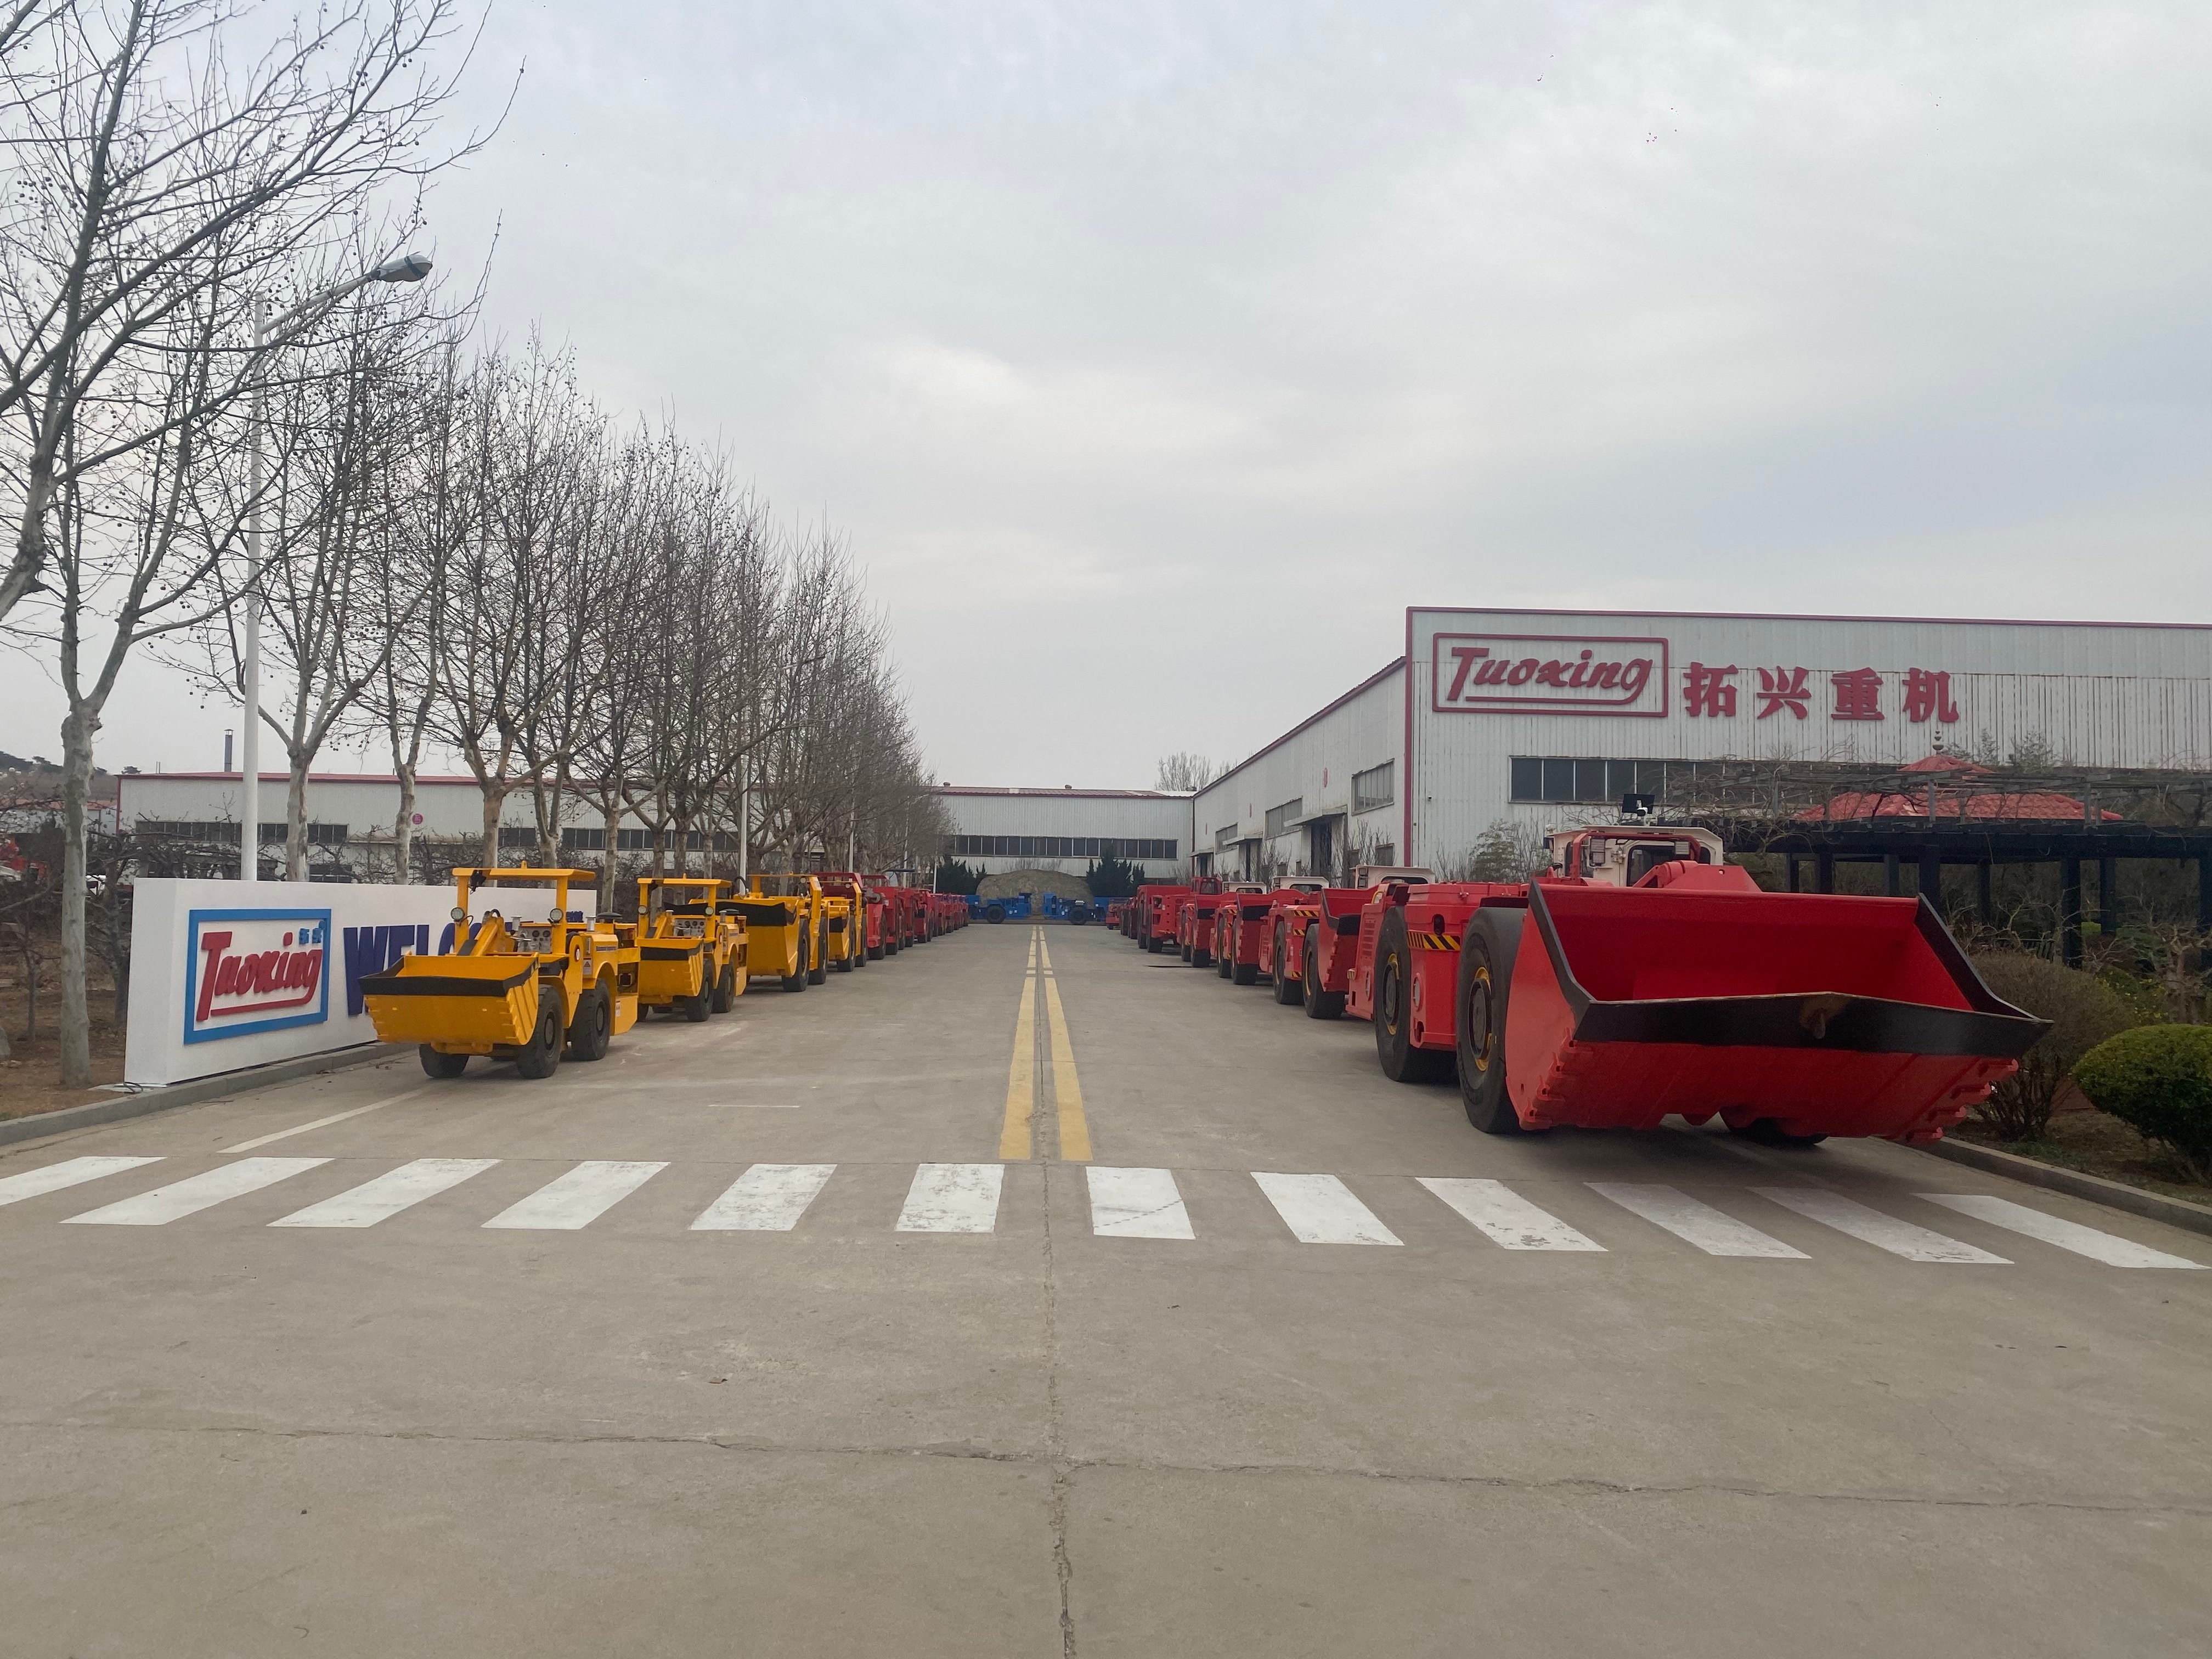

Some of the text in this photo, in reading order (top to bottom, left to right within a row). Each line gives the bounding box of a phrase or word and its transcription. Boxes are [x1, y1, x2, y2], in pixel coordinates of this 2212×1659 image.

[1447, 647, 1653, 705] Tuoxing
[1683, 662, 1959, 723] 拓兴重机
[196, 932, 323, 1022] Tuoxing
